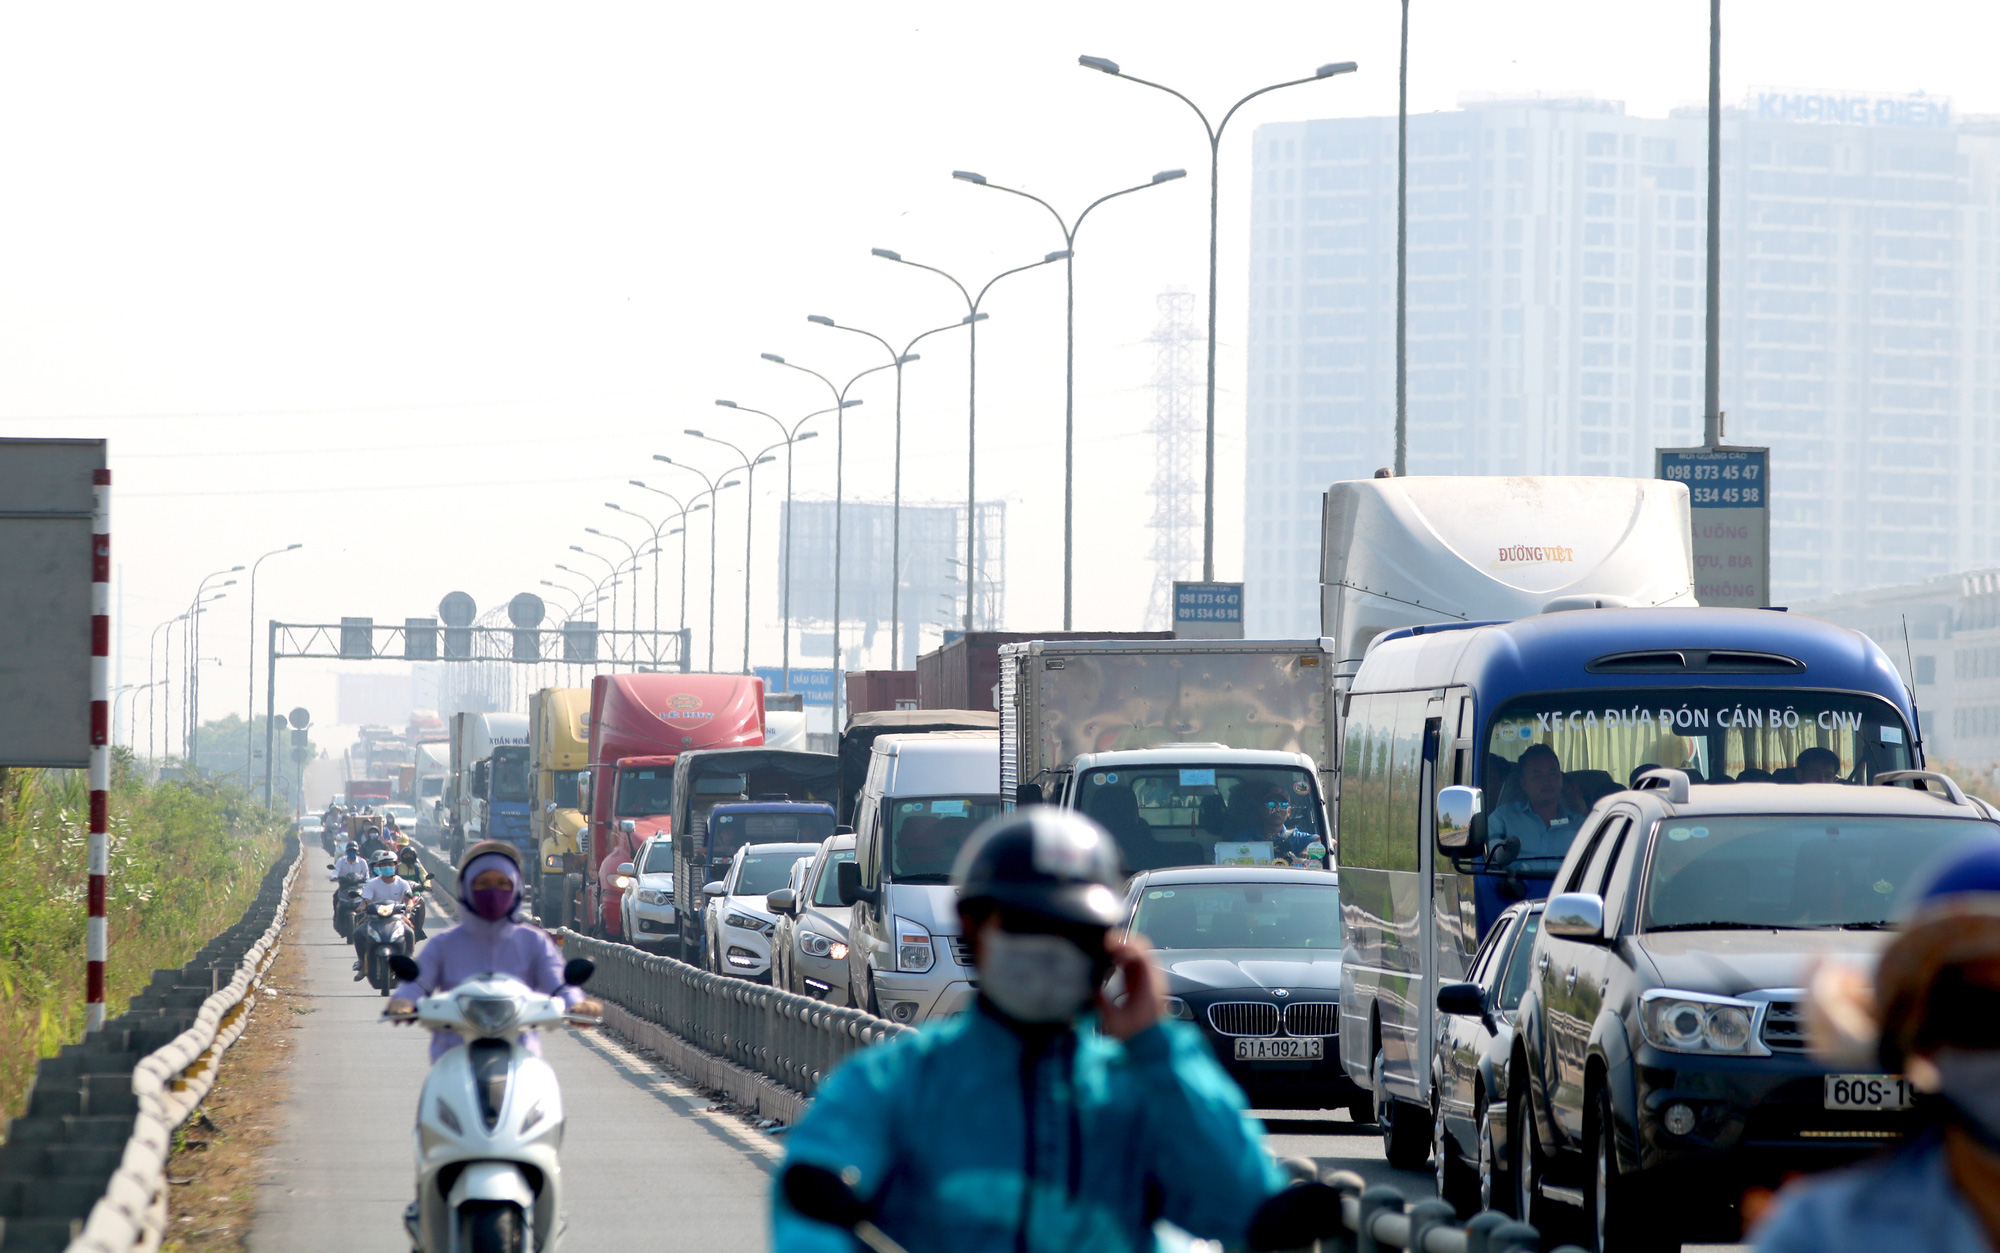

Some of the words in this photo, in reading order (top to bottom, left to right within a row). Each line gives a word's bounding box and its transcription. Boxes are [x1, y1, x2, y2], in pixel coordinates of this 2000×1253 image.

[1758, 93, 1870, 124] KHANG
[1666, 465, 1691, 479] 098
[1694, 465, 1719, 480] 873
[1722, 465, 1739, 480] 45
[1742, 465, 1759, 480] 47
[1694, 488, 1719, 502] 534
[1722, 488, 1739, 502] 45
[1742, 488, 1759, 502] 98
[1703, 522, 1748, 538] UỐNG
[1499, 544, 1543, 562] ĐƯỜNG
[1543, 545, 1573, 563] VIỆT
[1700, 581, 1755, 597] KHÔNG
[1180, 594, 1195, 604] 098
[1198, 594, 1213, 604] 873
[1215, 594, 1225, 604] 45
[1227, 595, 1238, 604] 47
[1179, 608, 1195, 618] 091
[1197, 608, 1213, 618] 534
[1215, 609, 1225, 618] 45
[1227, 609, 1238, 619] 98
[1536, 710, 1564, 733] XE
[1568, 709, 1599, 730] CA
[1603, 705, 1653, 729] ĐƯA
[1658, 703, 1709, 729] ĐÓN
[1716, 704, 1763, 729] CÁN
[1769, 706, 1800, 733] BỘ
[1817, 710, 1864, 732] CNV
[1239, 1041, 1320, 1057] 61A-092.13
